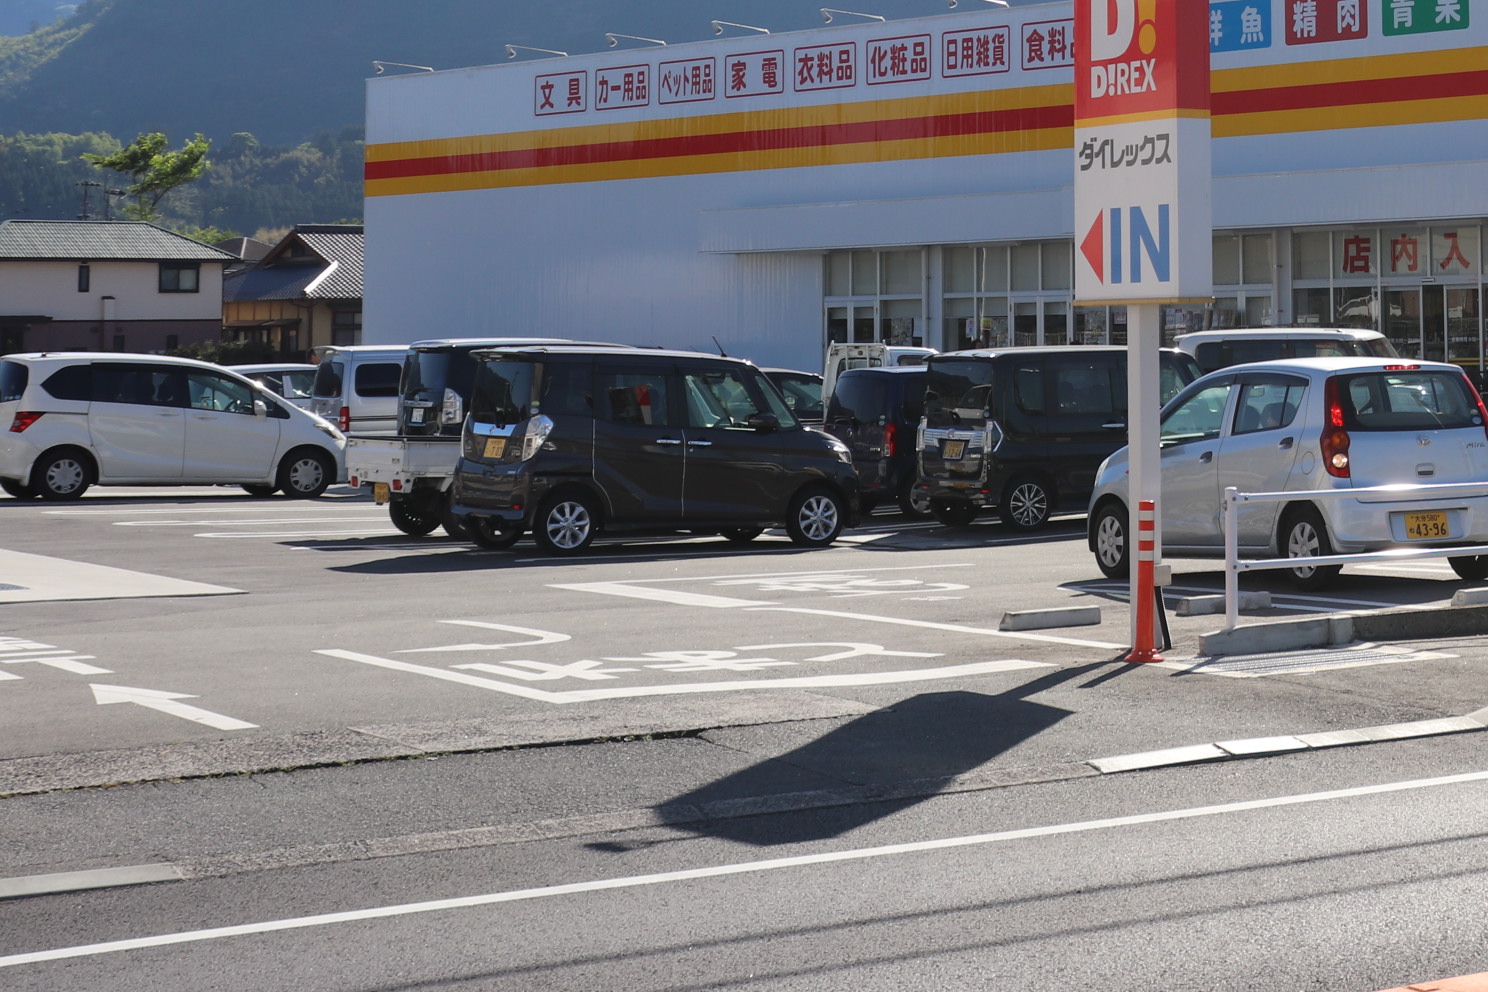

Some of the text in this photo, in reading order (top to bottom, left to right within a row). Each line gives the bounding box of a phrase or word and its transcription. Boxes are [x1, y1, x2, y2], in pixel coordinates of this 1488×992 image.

[870, 41, 928, 79] 化粧品
[946, 33, 1006, 70] 日用雑貨
[1026, 25, 1075, 64] 食料
[661, 64, 713, 97] ペット用品
[731, 57, 778, 91] 家電
[797, 49, 853, 85] 衣料品
[540, 78, 582, 110] 文具
[598, 71, 647, 104] カー用品
[1078, 132, 1173, 171] ダイレックス
[1110, 204, 1171, 285] IN
[1416, 522, 1447, 537] 43-96
